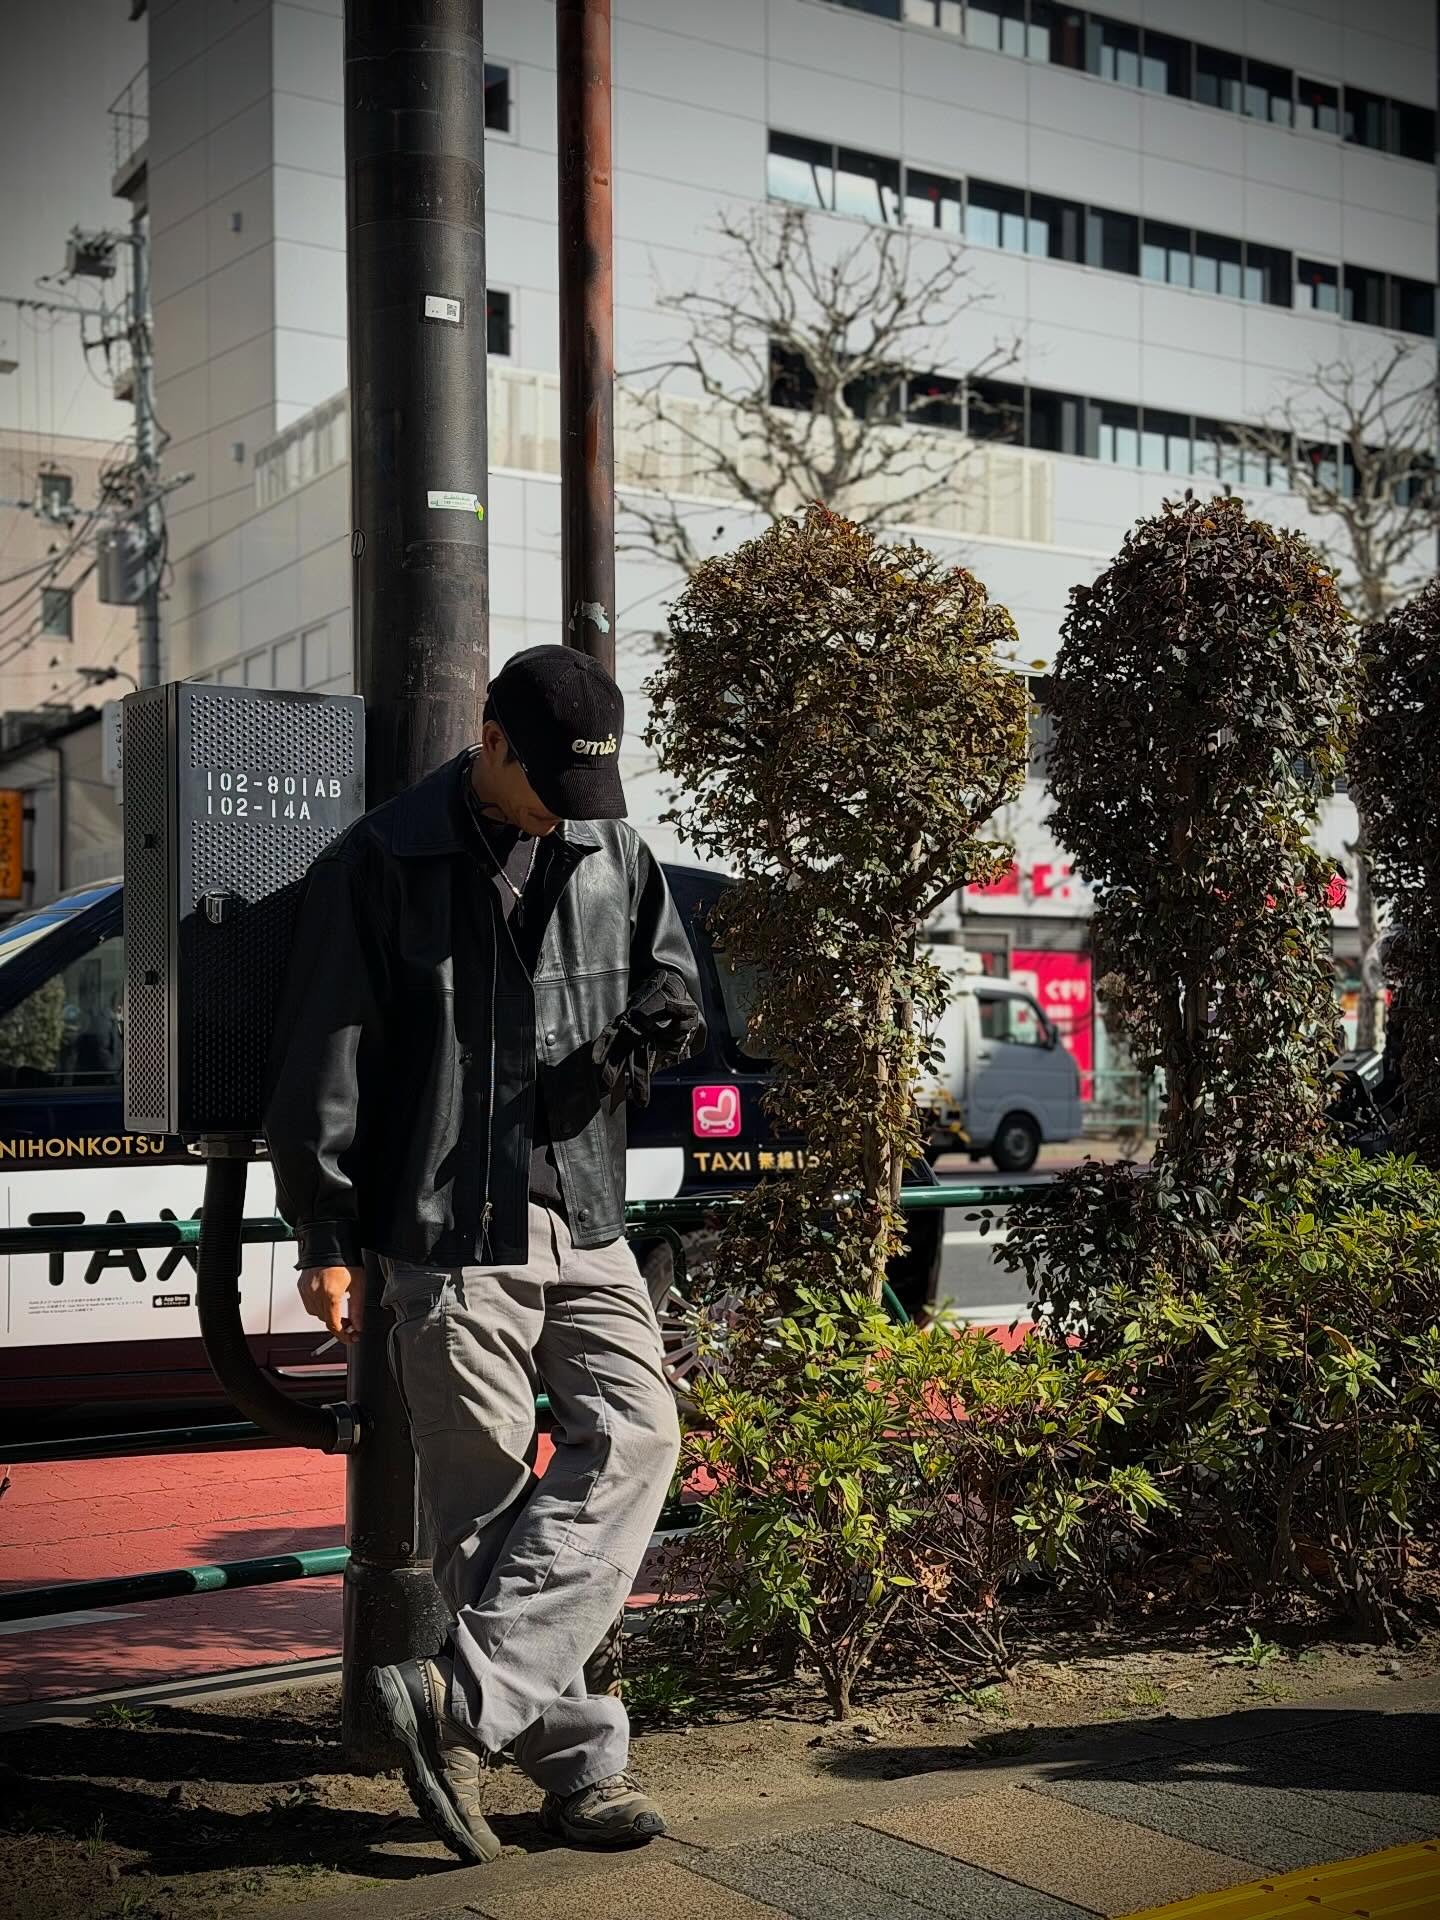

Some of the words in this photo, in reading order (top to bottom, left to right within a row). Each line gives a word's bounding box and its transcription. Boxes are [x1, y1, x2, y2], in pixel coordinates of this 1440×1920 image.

[571, 733, 616, 755] emis
[207, 771, 341, 798] 102-801AB
[207, 795, 311, 820] 102-14A
[0, 1135, 165, 1159] NIHONKOTSU
[693, 1152, 751, 1172] TAXI
